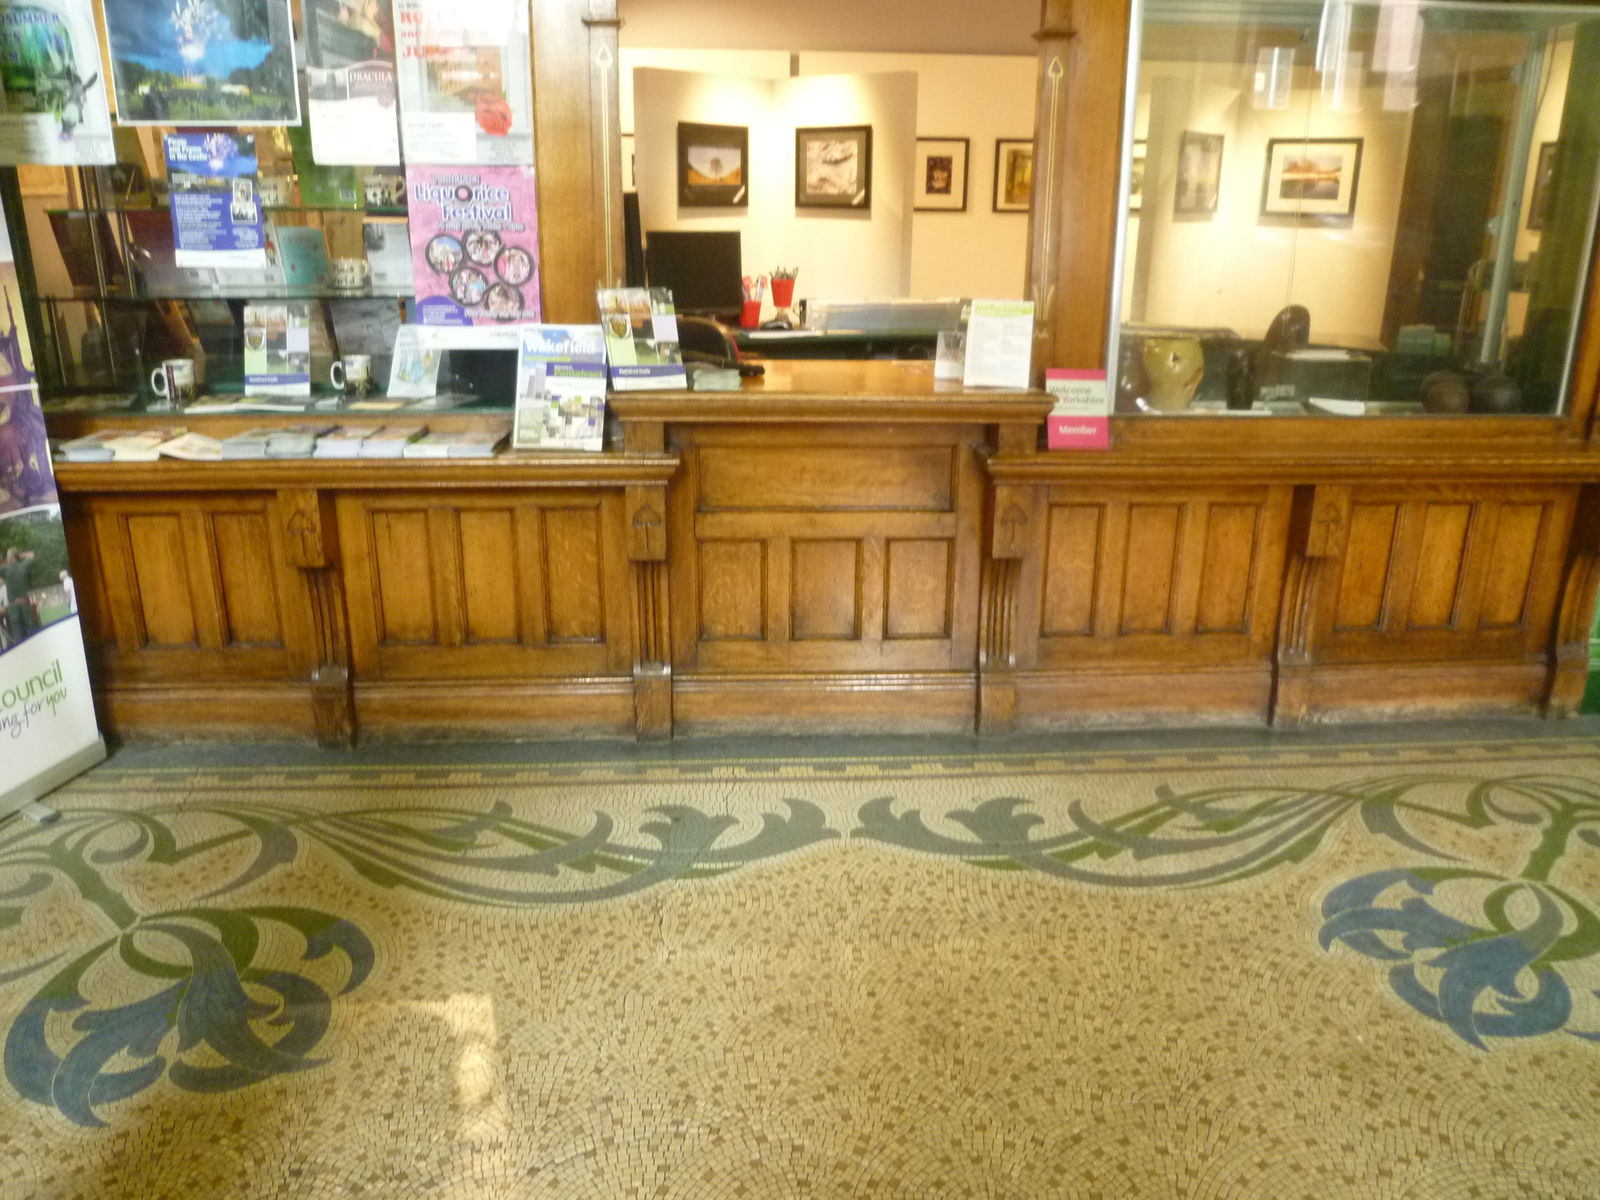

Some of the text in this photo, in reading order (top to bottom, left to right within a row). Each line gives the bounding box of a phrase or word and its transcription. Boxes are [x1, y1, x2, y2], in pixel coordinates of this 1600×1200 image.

[349, 71, 393, 83] DRACULA
[414, 184, 510, 205] Liquorice
[441, 202, 512, 222] Festival
[525, 339, 596, 355] Wakefield
[1049, 385, 1092, 394] Welcome
[1063, 395, 1104, 405] Yorkshire
[1059, 425, 1097, 435] Member
[1, 658, 63, 709] ouncil
[23, 698, 44, 728] for
[46, 687, 67, 717] you
